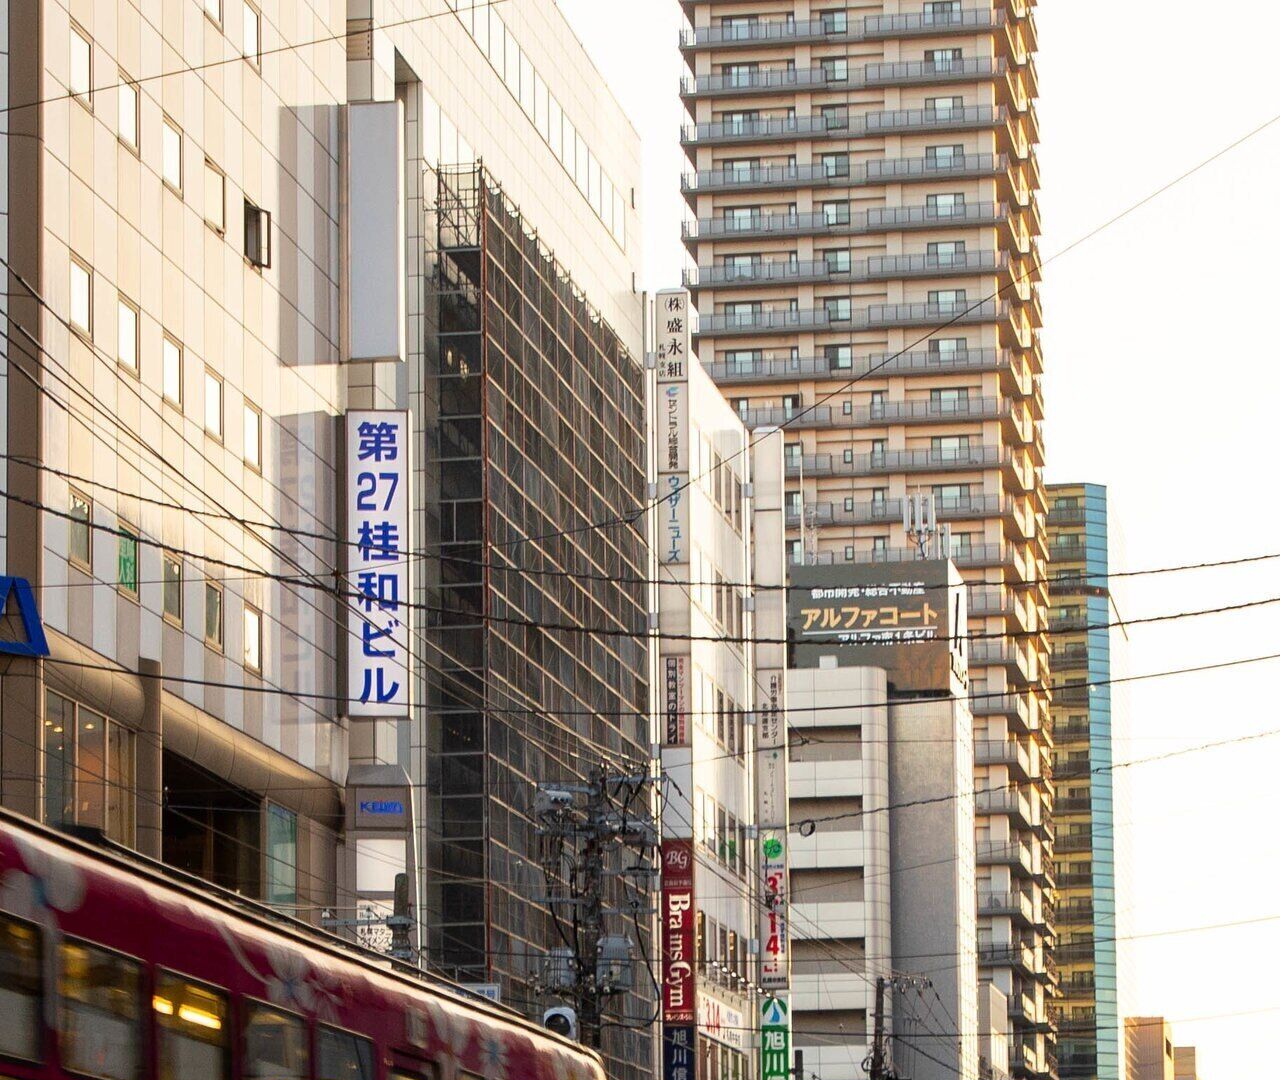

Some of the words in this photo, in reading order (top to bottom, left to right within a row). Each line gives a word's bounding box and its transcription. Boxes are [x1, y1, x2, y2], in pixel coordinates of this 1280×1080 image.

[356, 420, 400, 705] 第27桂和ビル
[801, 602, 938, 630] アルファコート
